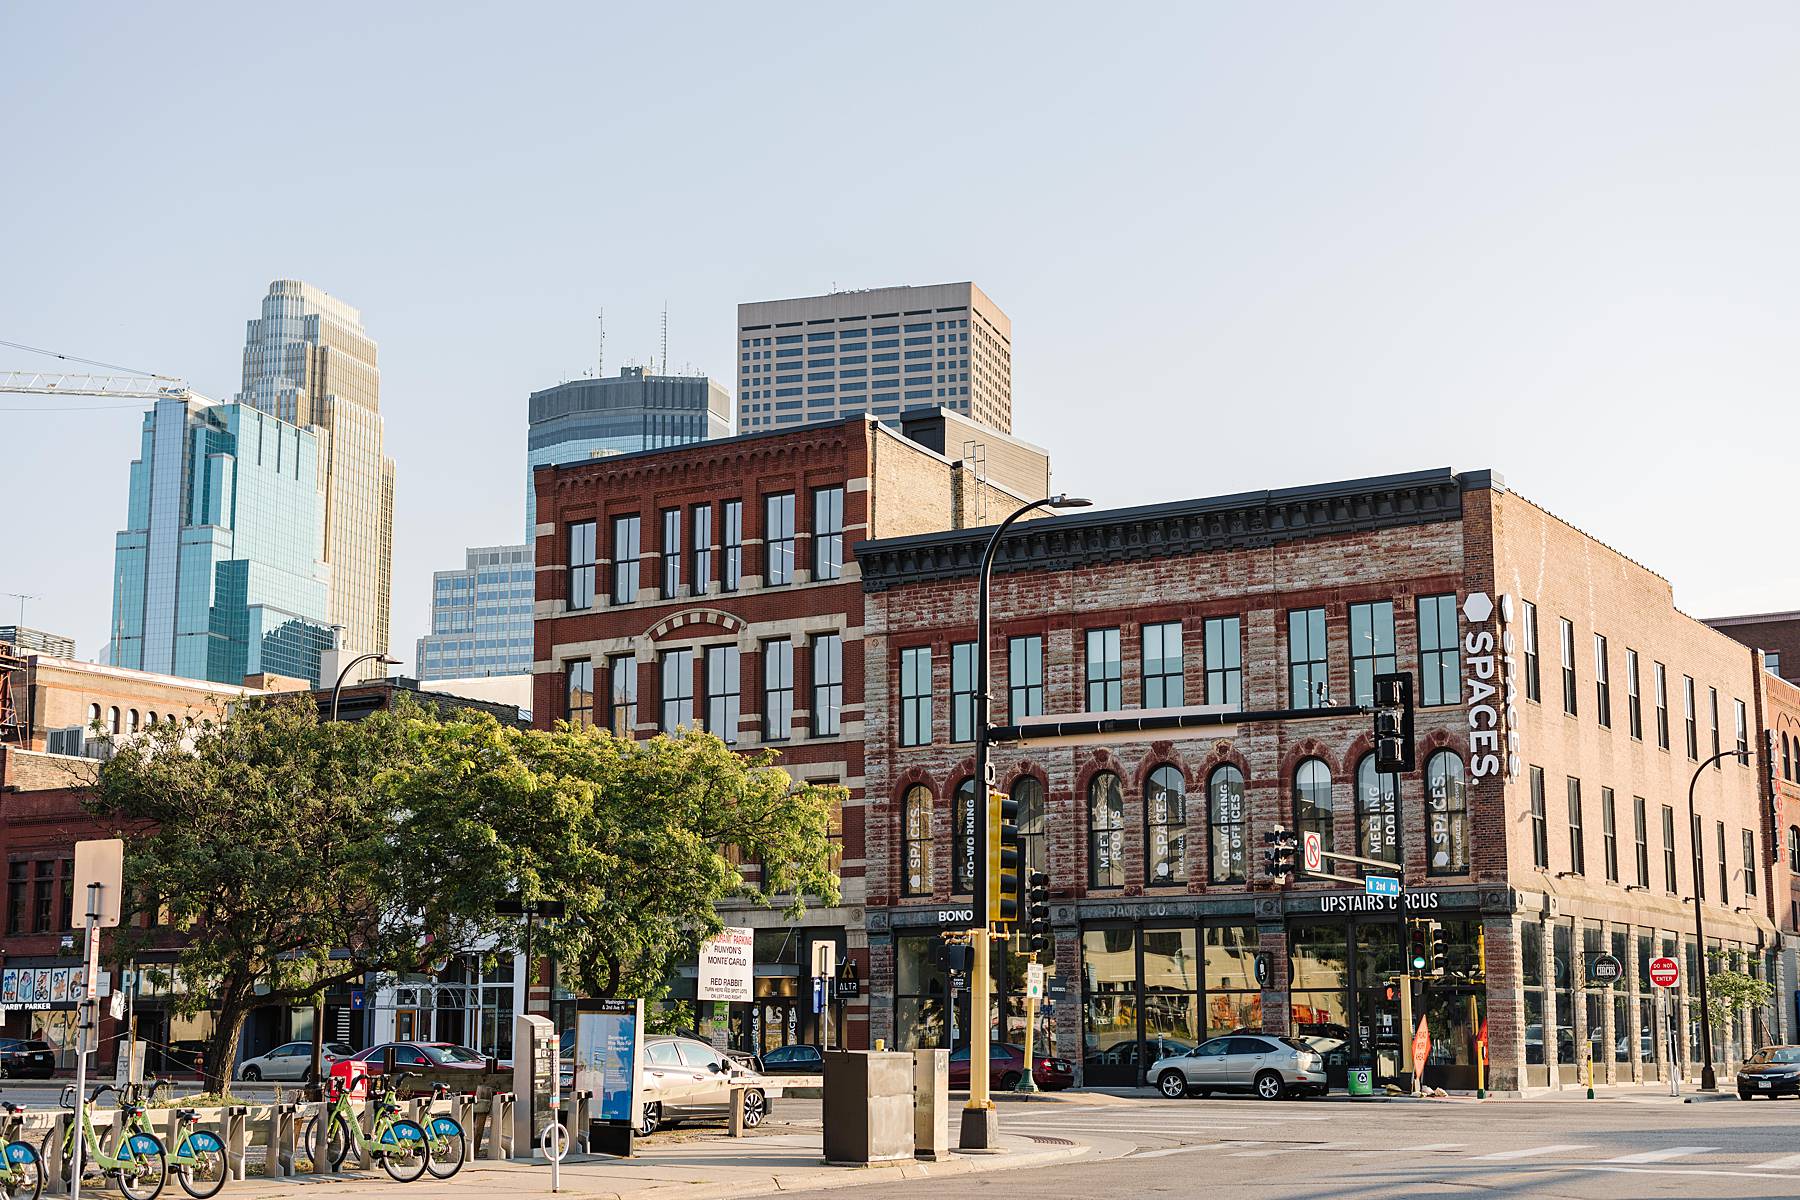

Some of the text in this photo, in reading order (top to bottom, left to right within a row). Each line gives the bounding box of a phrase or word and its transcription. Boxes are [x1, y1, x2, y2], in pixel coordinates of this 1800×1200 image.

[1465, 631, 1499, 786] SPACES.
[1099, 805, 1110, 868] MEETING
[1111, 810, 1121, 861] ROOMS
[1155, 787, 1168, 856] SPACES.
[1219, 784, 1230, 868] CO-WORKING
[1230, 793, 1242, 861] & OFFICES
[1369, 786, 1382, 853] MEETING
[1384, 791, 1396, 846] ROOMS
[1431, 772, 1448, 844] SPACES.
[966, 799, 975, 878] CO-WORKING
[1321, 893, 1438, 912] UPSTAIRS CRCUS
[1369, 881, 1373, 890] N
[1375, 881, 1386, 891] 2nd
[708, 956, 747, 967] MONTE CARLO
[714, 945, 742, 955] RUNYON'S
[24, 1002, 51, 1010] PARKER
[710, 978, 743, 987] RED RABBIT
